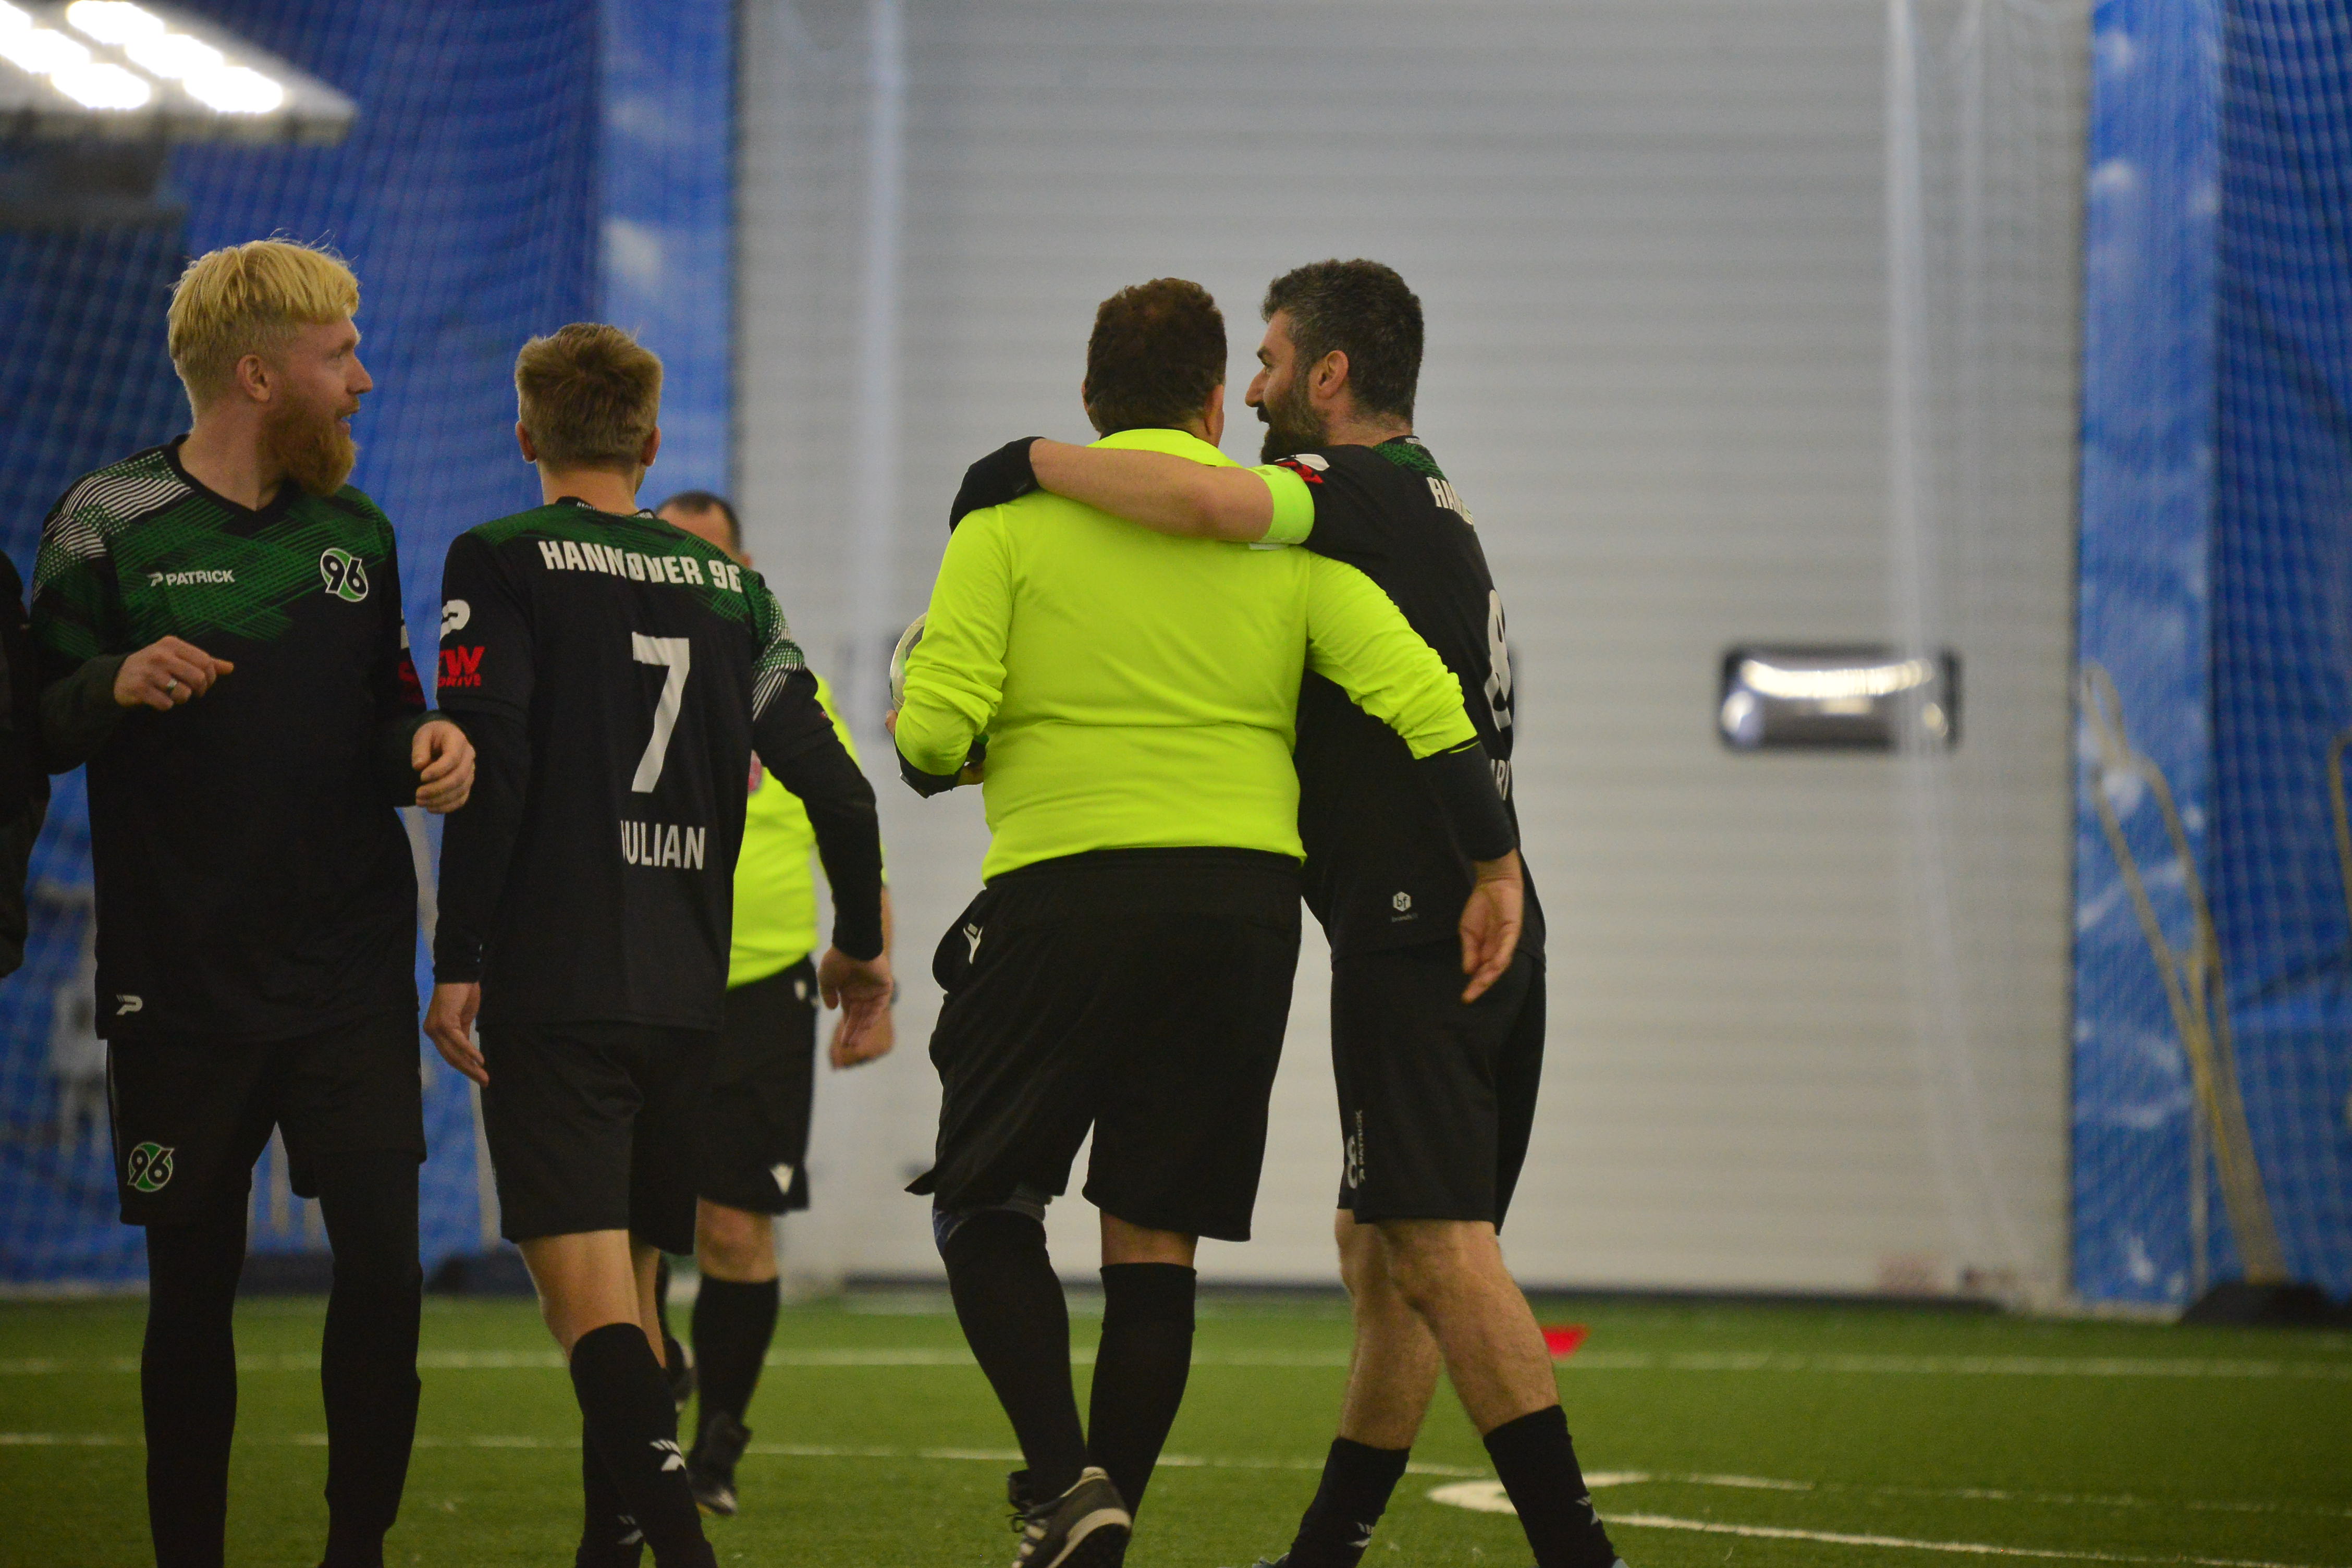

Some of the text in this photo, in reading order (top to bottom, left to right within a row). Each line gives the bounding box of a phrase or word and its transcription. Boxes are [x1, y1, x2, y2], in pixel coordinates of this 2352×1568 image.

[166, 569, 236, 586] PATRICK
[321, 552, 368, 596] 96
[537, 541, 743, 593] HANNOVER 96
[631, 630, 690, 793] 7
[127, 1146, 174, 1187] 96
